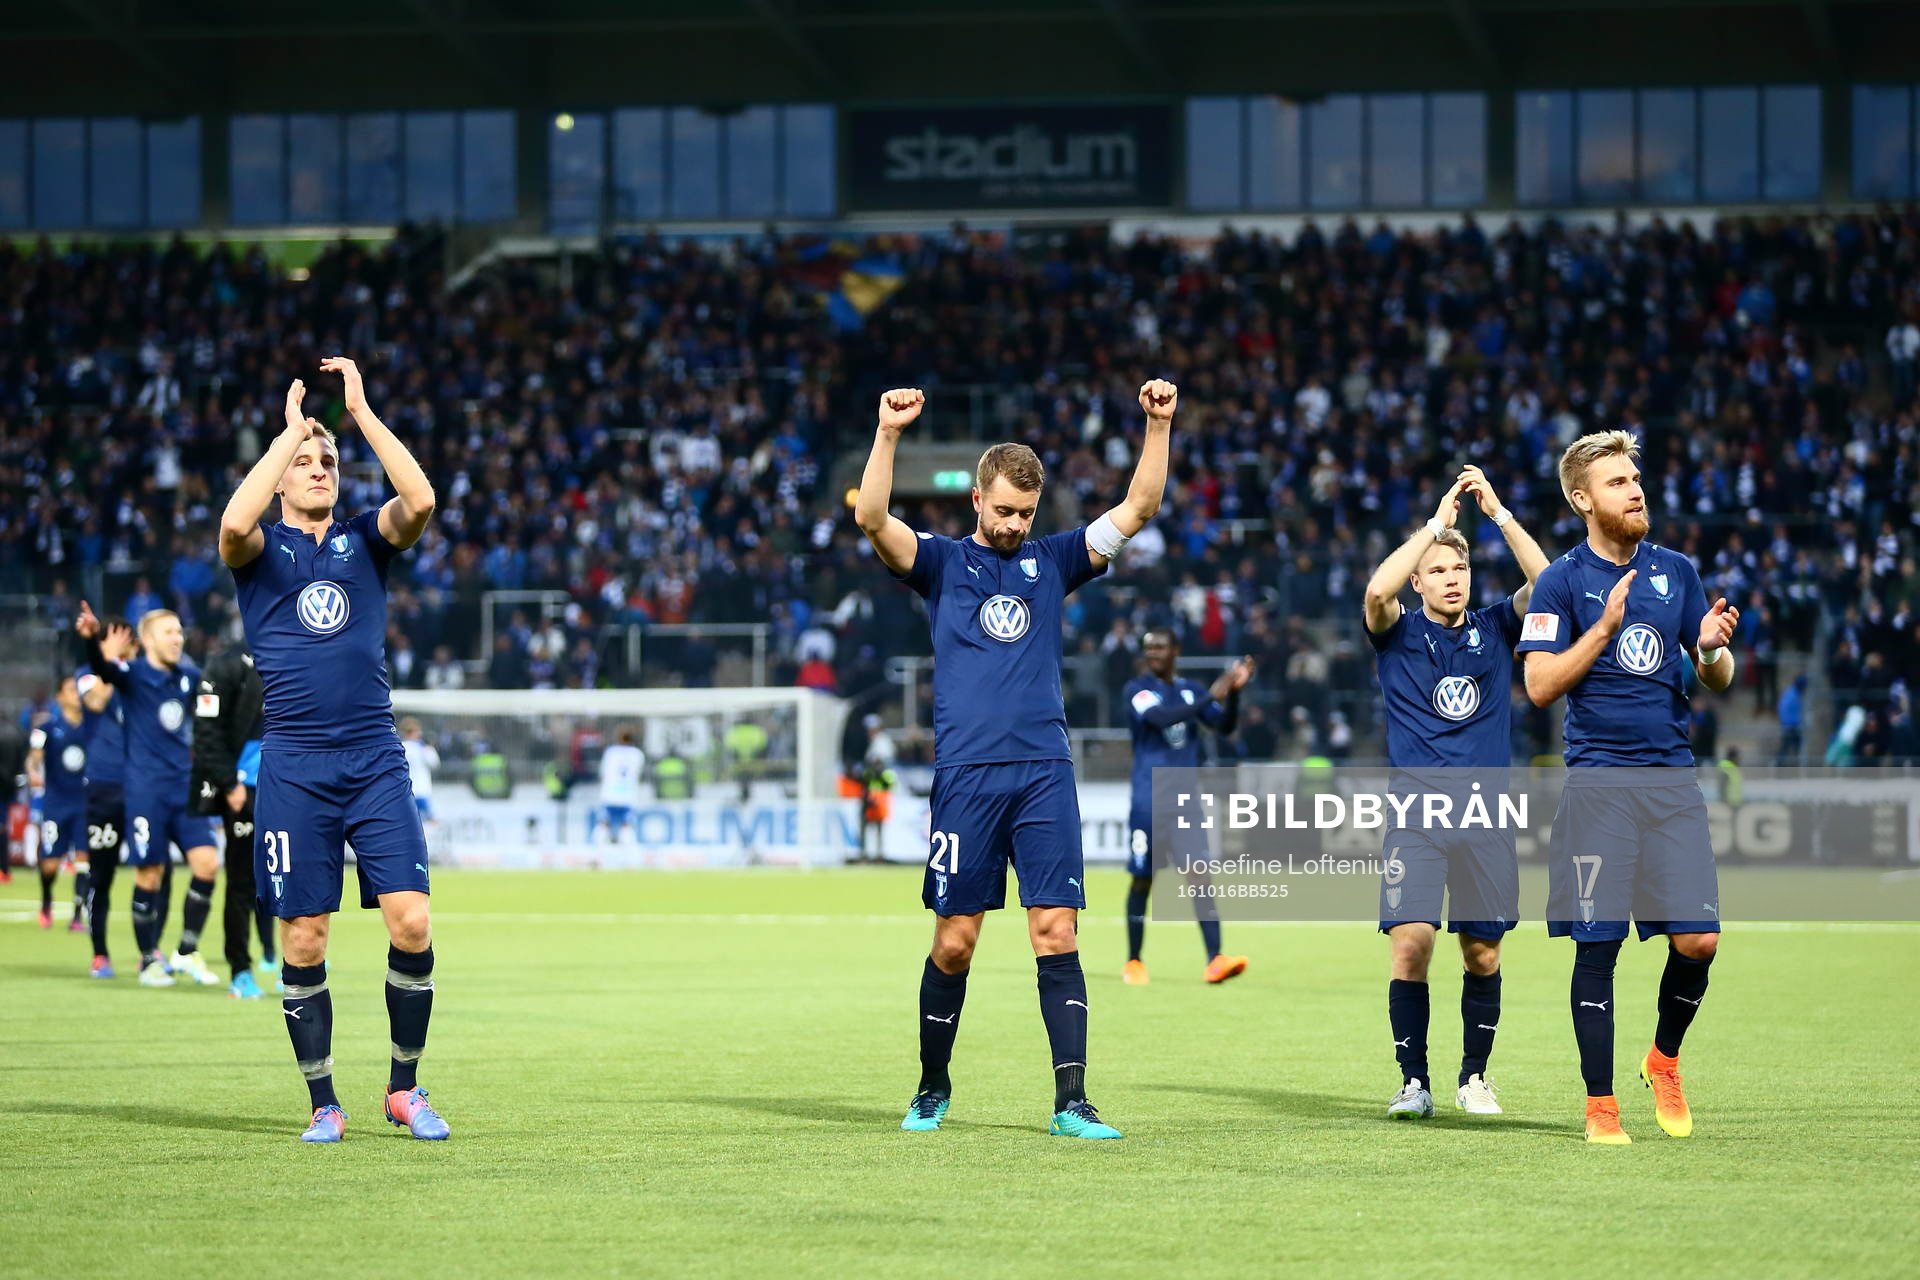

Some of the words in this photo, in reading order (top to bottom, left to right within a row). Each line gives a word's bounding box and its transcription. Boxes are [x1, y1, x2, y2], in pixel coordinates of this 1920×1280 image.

[883, 123, 1136, 181] stadium
[88, 823, 118, 849] 26
[133, 816, 150, 845] 3
[264, 831, 291, 873] 31
[929, 830, 960, 874] 21
[1383, 846, 1405, 884] 6
[1573, 855, 1603, 899] 17
